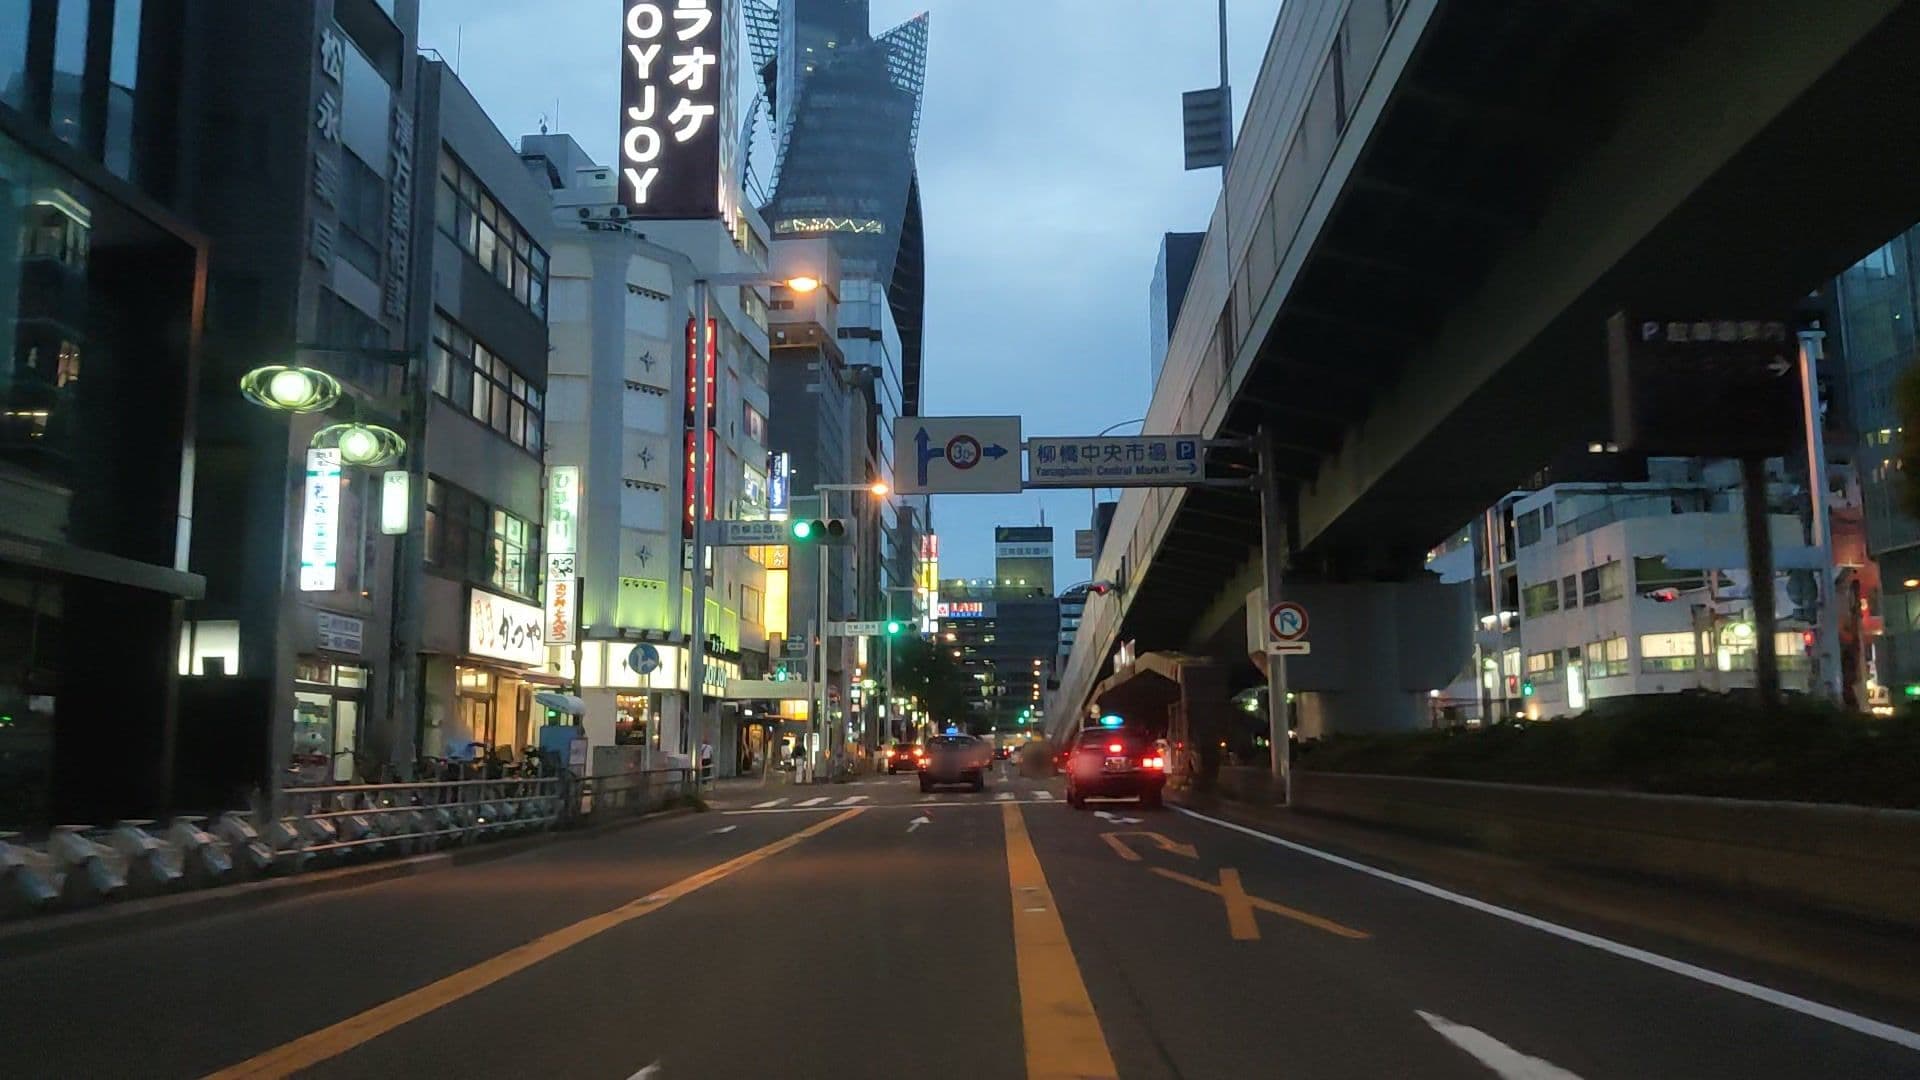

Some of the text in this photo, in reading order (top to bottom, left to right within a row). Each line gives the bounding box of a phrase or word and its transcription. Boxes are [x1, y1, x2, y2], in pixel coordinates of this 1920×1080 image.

[624, 4, 663, 204] OYJOY
[1037, 442, 1167, 464] 柳橋中央市場
